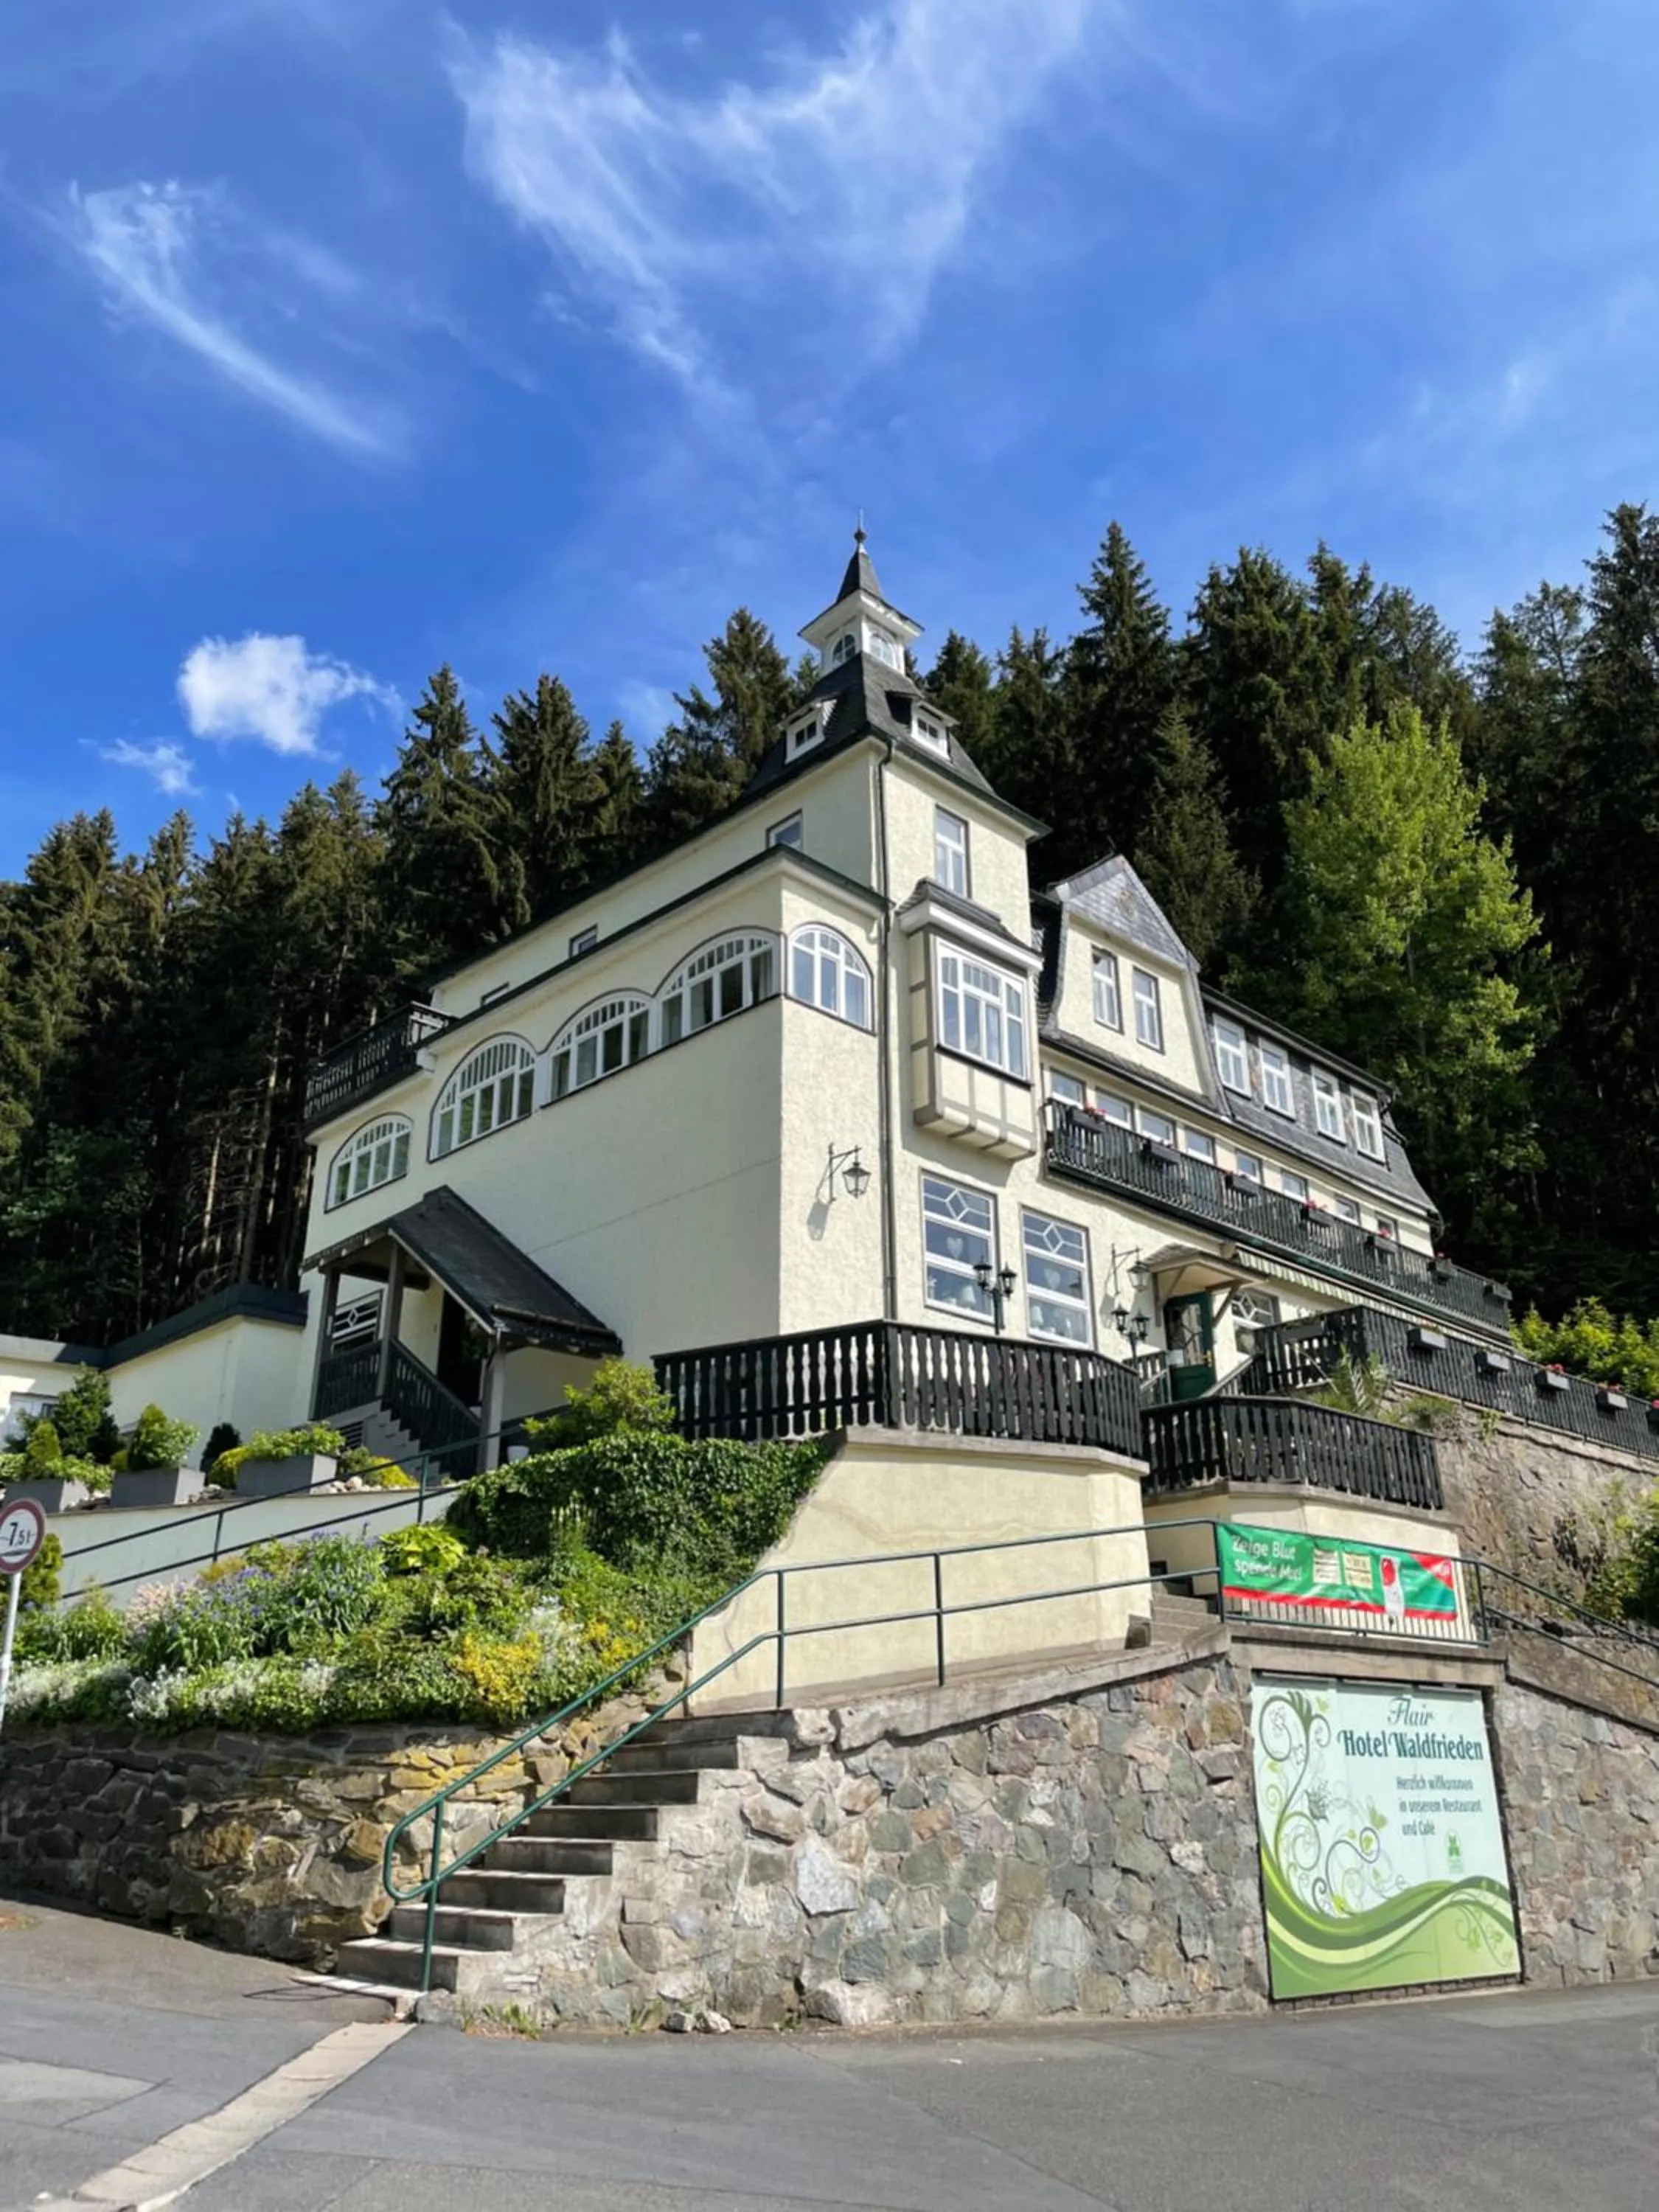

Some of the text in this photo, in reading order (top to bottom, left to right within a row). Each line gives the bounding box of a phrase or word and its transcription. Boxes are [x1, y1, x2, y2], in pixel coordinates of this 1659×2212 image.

[1387, 1696, 1435, 1727] Flair
[1337, 1730, 1484, 1760] Hotel Waldfrieden
